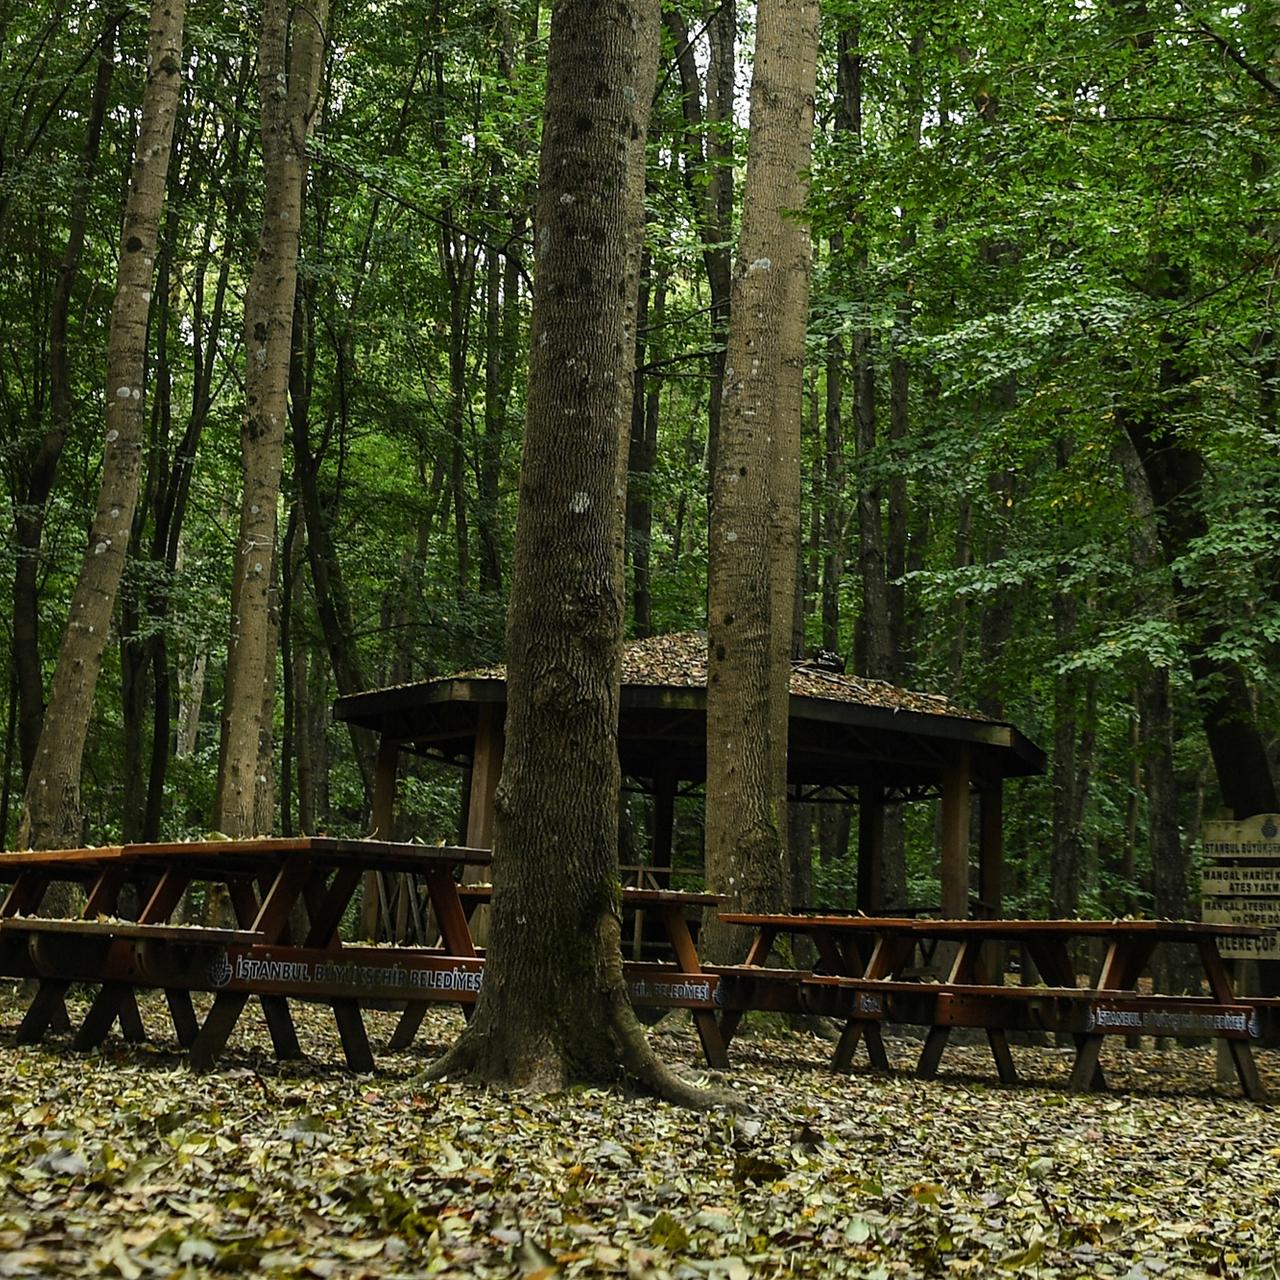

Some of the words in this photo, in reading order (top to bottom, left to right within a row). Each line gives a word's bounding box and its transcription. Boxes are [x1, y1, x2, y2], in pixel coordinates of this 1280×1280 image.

[1203, 871, 1240, 881] MANGAL
[1204, 901, 1240, 911] MANGAL
[235, 954, 312, 983] İSTANBUL
